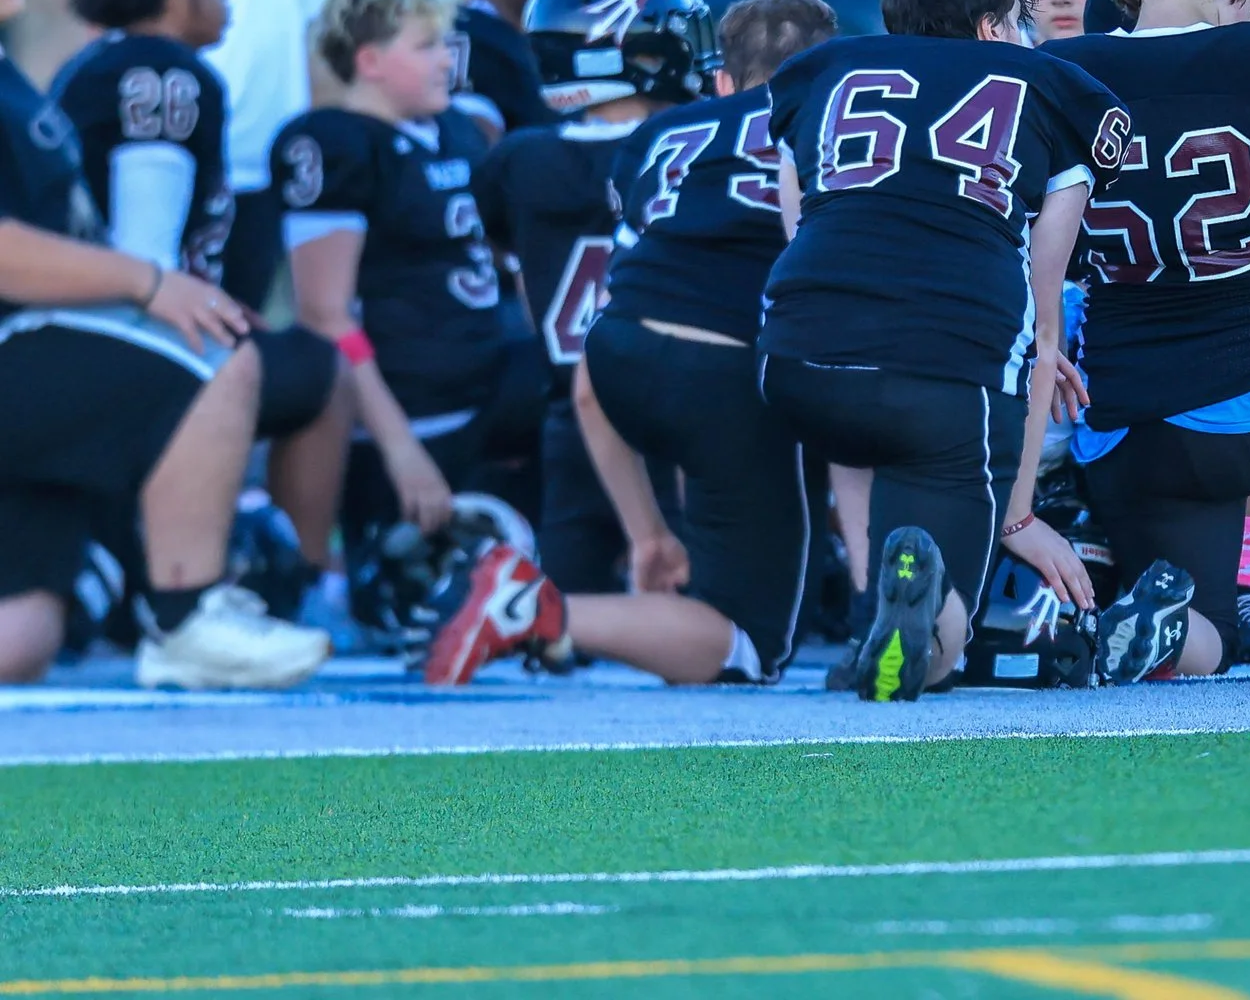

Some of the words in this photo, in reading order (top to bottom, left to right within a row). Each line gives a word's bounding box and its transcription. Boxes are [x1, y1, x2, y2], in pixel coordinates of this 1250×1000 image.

[118, 66, 201, 141] 26
[817, 69, 1028, 219] 64
[283, 136, 323, 207] 3
[444, 193, 499, 309] 3
